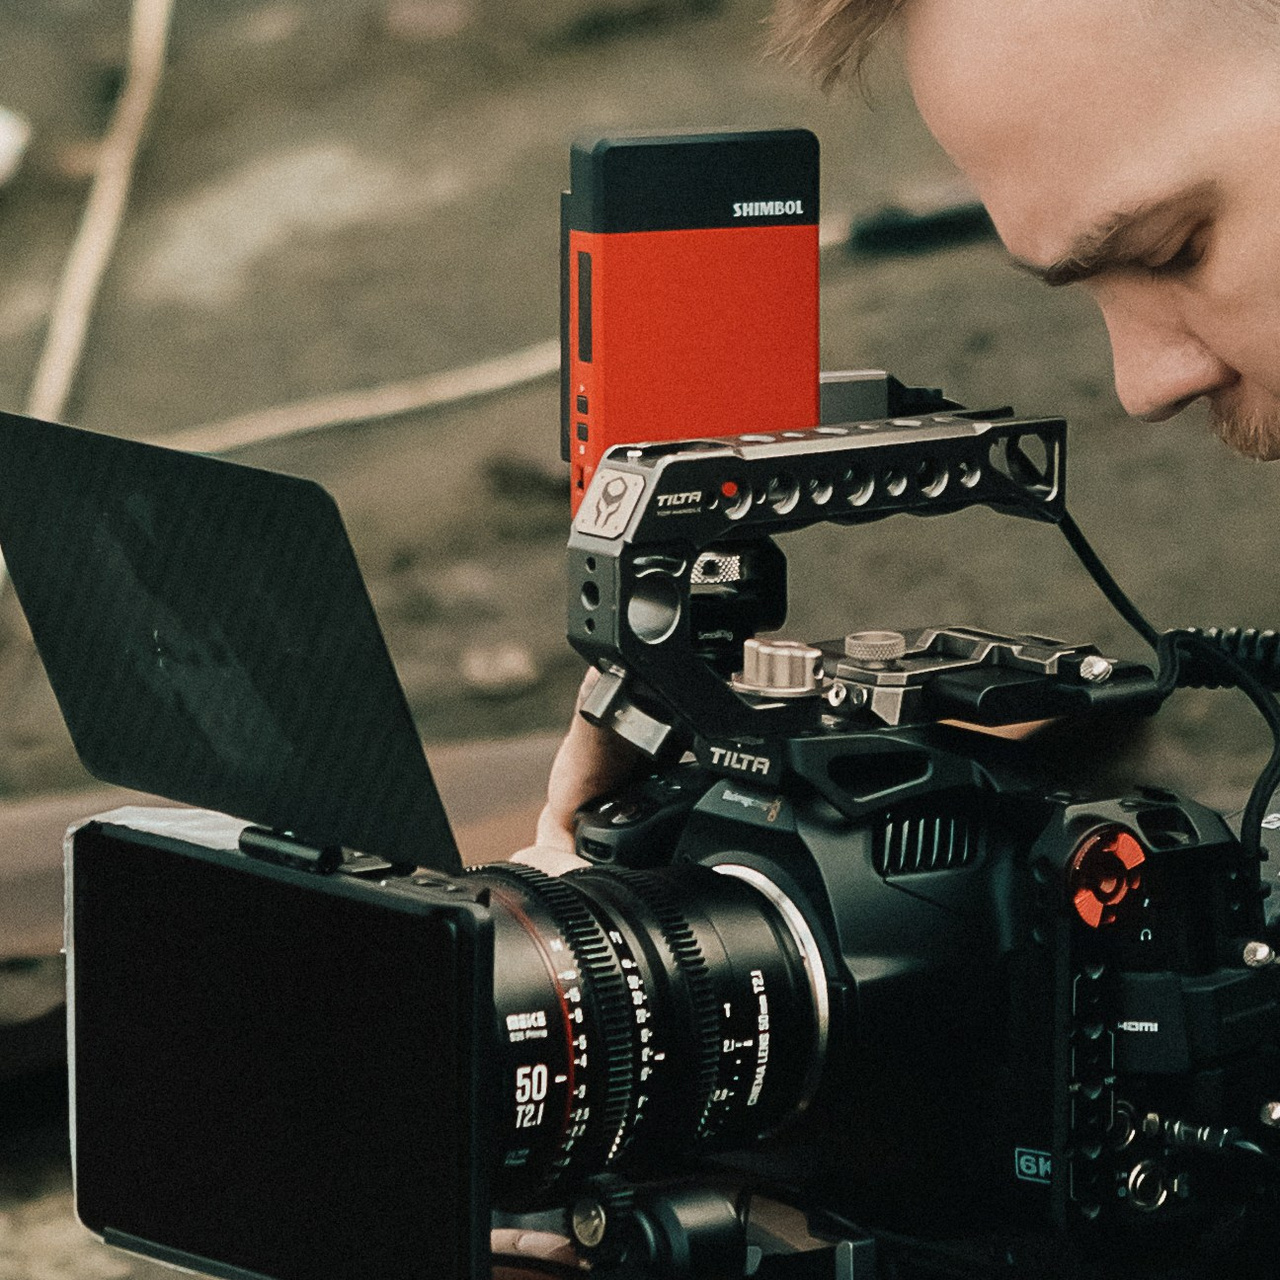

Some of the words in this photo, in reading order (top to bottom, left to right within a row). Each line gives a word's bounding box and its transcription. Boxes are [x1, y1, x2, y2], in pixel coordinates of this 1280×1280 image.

[733, 200, 804, 217] SHIMBOL
[657, 491, 702, 507] TILTA
[709, 746, 770, 775] TILTA
[515, 1064, 548, 1103] 50
[515, 1102, 545, 1129] T2.1
